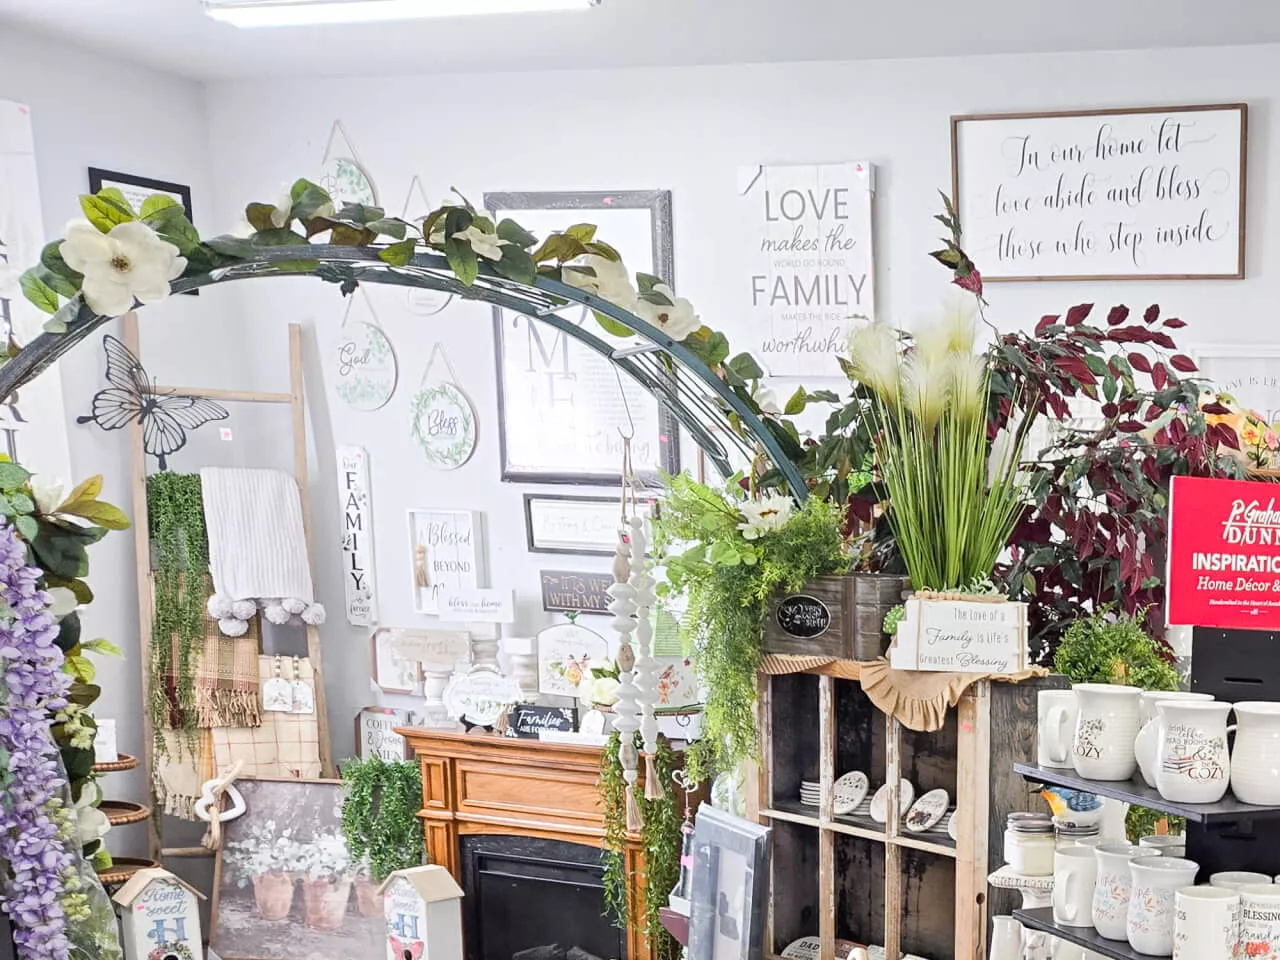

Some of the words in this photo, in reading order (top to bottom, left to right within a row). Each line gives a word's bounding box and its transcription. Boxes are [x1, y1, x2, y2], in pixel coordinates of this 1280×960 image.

[1004, 134, 1043, 176] In
[1051, 143, 1083, 162] our
[1096, 123, 1145, 160] home
[996, 183, 1031, 216] love
[1045, 173, 1096, 211] abide
[1107, 166, 1150, 207] and
[1155, 165, 1201, 200] bless
[765, 188, 849, 221] LOVE
[760, 224, 819, 252] makes
[824, 223, 856, 252] the
[998, 227, 1043, 261] those
[1056, 220, 1094, 256] who
[1108, 221, 1144, 269] step
[1156, 208, 1217, 246] inside
[752, 274, 866, 306] FAMILY
[338, 342, 371, 376] God
[427, 522, 472, 546] Blessed
[433, 560, 471, 572] BEYOND
[1197, 576, 1232, 591] Home
[1235, 577, 1271, 592] Décor
[1272, 579, 1280, 592] &
[550, 593, 580, 608] WITH
[582, 596, 600, 609] MY
[954, 608, 967, 620] The
[926, 627, 973, 648] Family
[919, 655, 953, 665] Greatest
[956, 652, 1009, 671] Blessing
[517, 709, 565, 728] Families
[1076, 745, 1102, 759] OZY
[1188, 766, 1224, 779] COZY
[142, 887, 185, 903] Home
[799, 941, 820, 951] DAD
